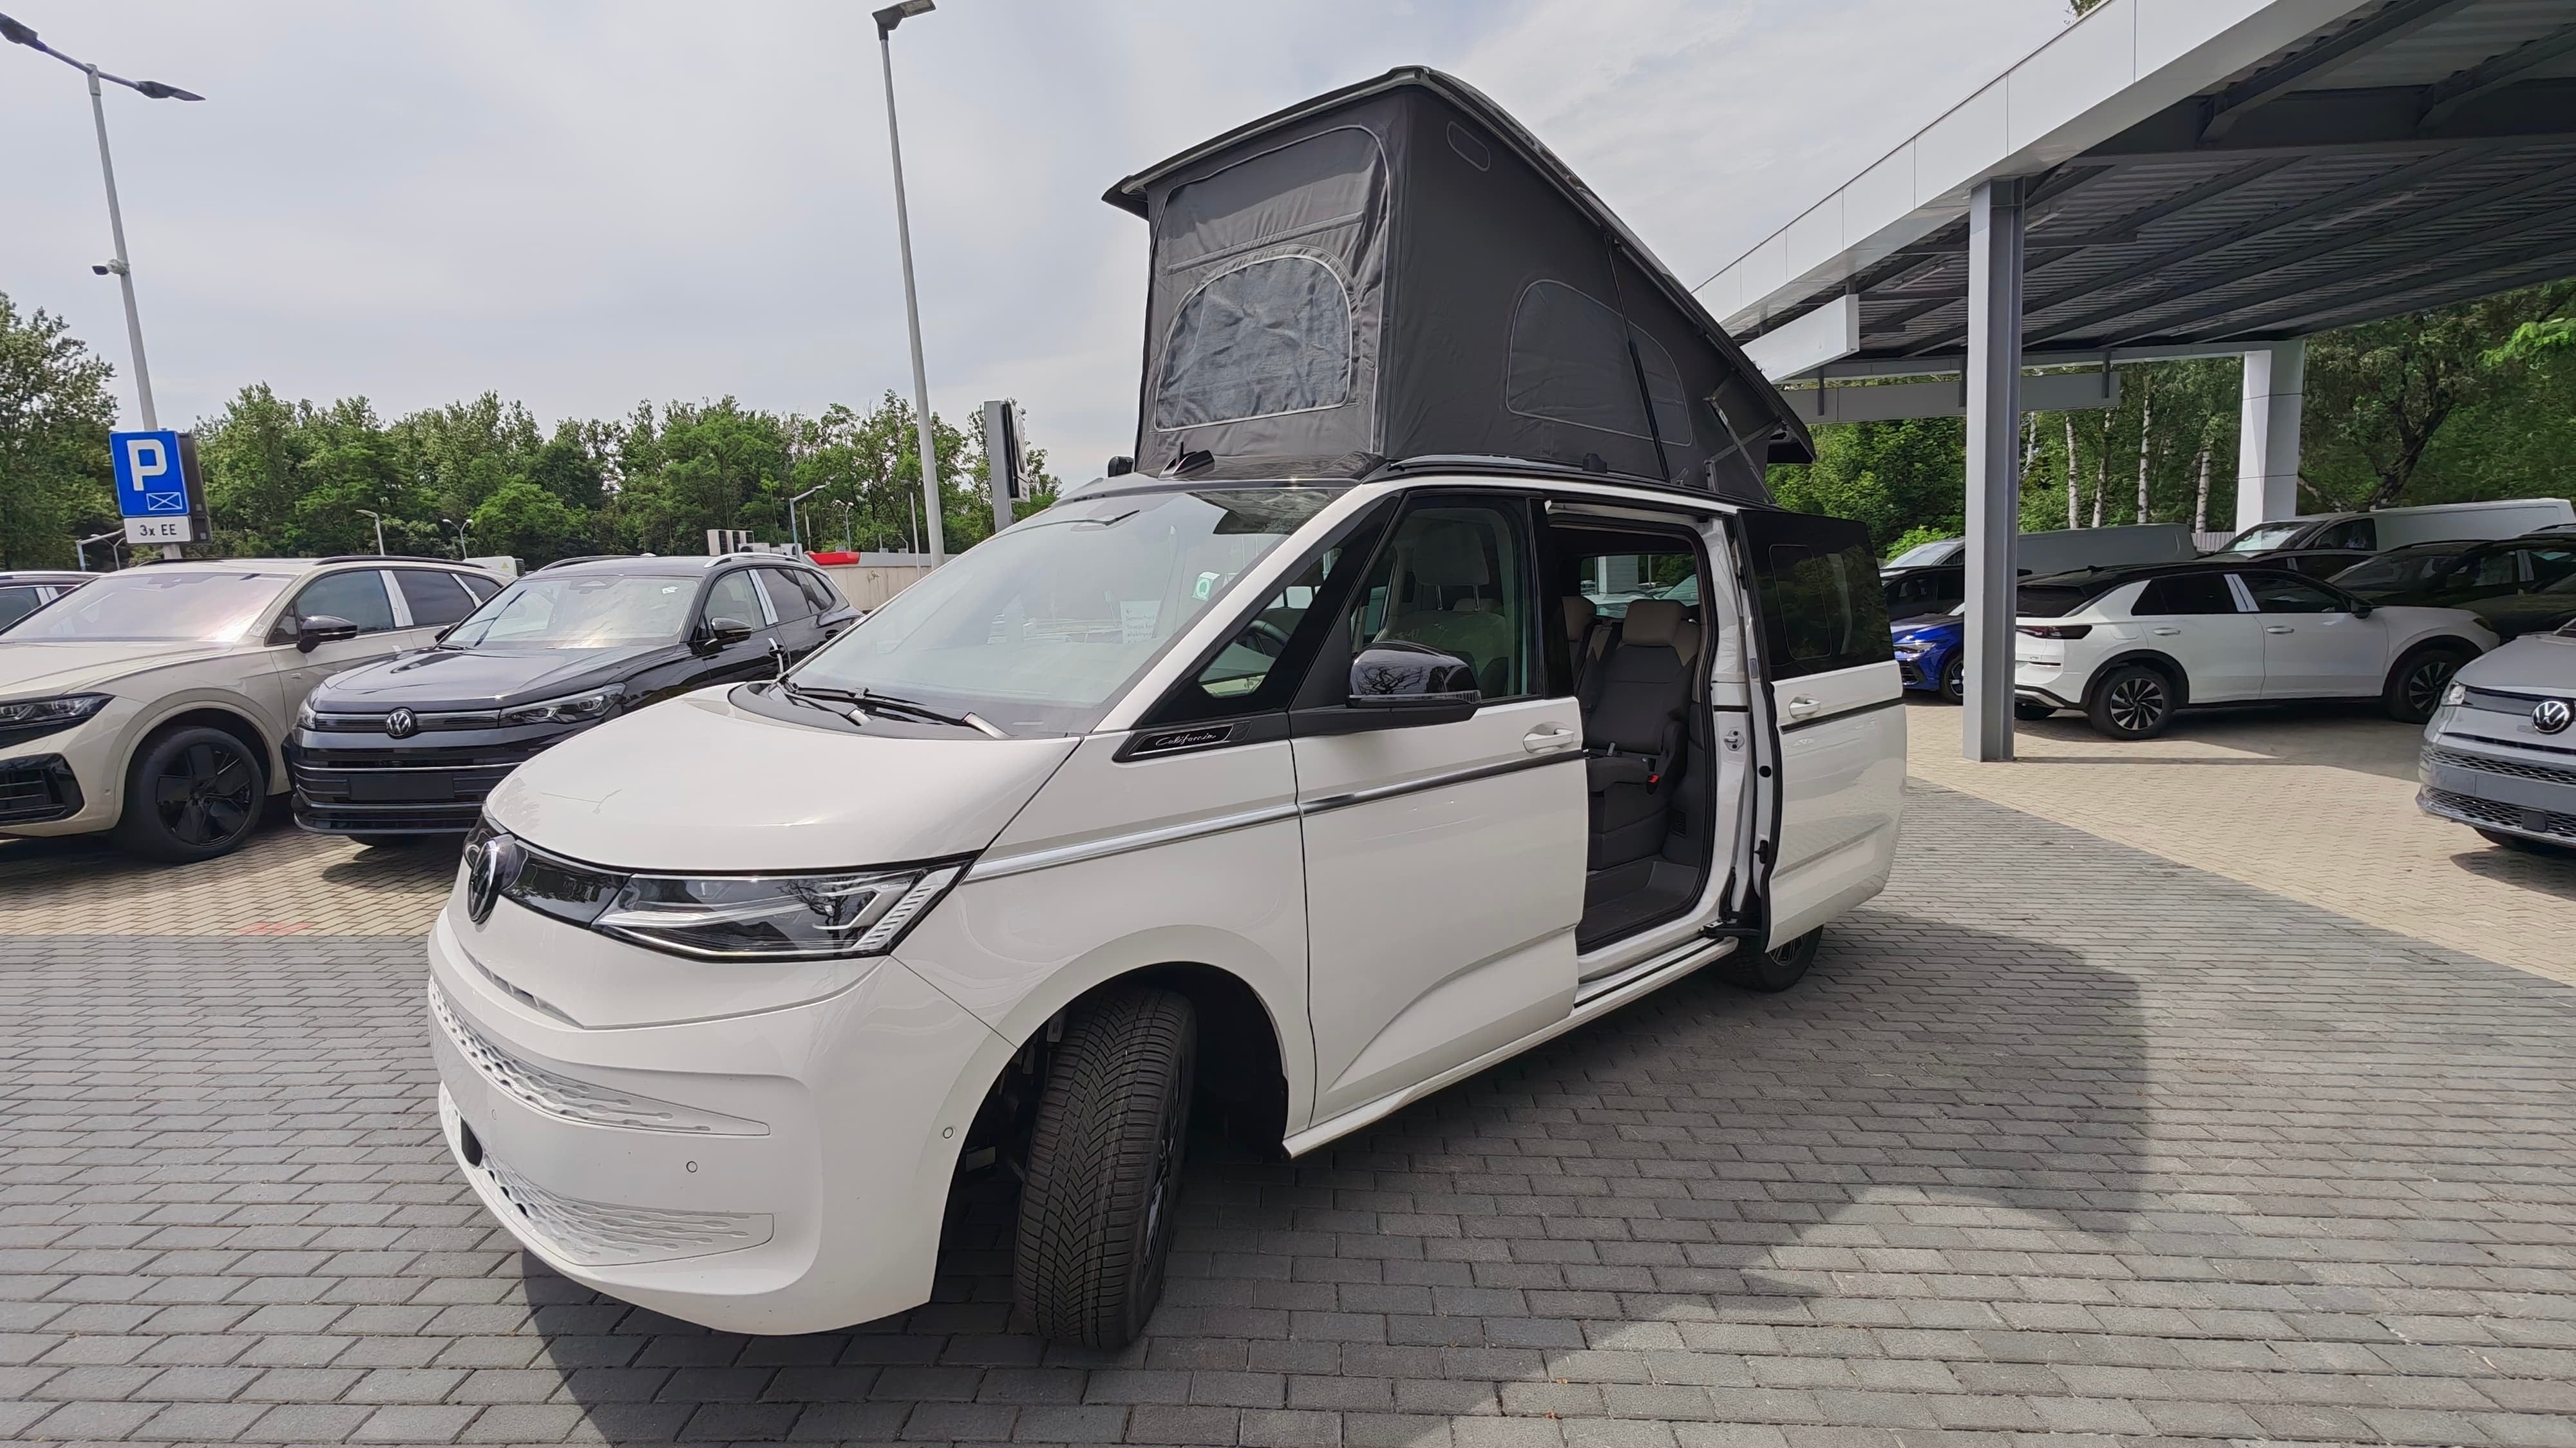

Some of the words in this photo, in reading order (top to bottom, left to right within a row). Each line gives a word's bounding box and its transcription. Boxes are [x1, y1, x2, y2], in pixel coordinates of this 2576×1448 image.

[127, 439, 167, 491] P
[140, 524, 155, 536] 3x
[161, 524, 177, 535] EE
[386, 712, 411, 736] VW
[2532, 701, 2570, 732] VW
